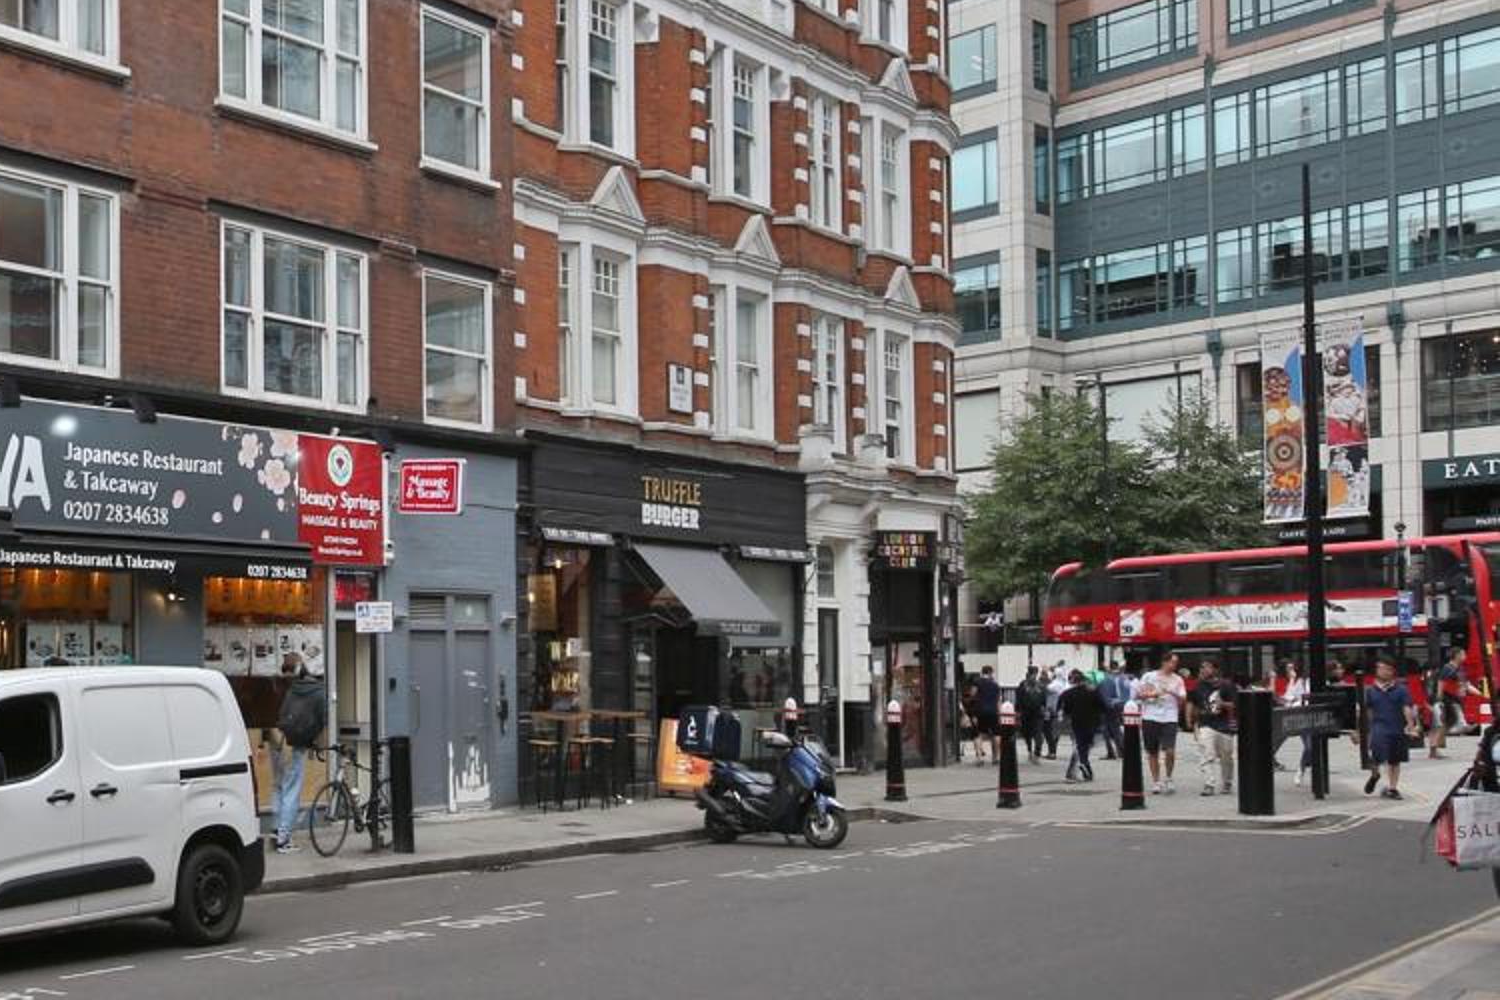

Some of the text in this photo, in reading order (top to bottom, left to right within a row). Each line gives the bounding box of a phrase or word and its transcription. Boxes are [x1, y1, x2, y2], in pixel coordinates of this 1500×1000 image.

[63, 442, 224, 476] Japanese Restaurant
[1444, 459, 1500, 479] EAT
[63, 470, 159, 499] & Takeaway
[641, 476, 703, 505] TRUFFLE
[63, 501, 170, 525] 0207 2834638
[299, 488, 381, 517] Beauty Springs
[301, 514, 338, 527] MASSAGE
[349, 518, 379, 530] BEAUTY
[640, 504, 700, 529] BURGER
[53, 551, 114, 568] Restaurant
[115, 555, 124, 568] &
[126, 555, 177, 573] Takeaway
